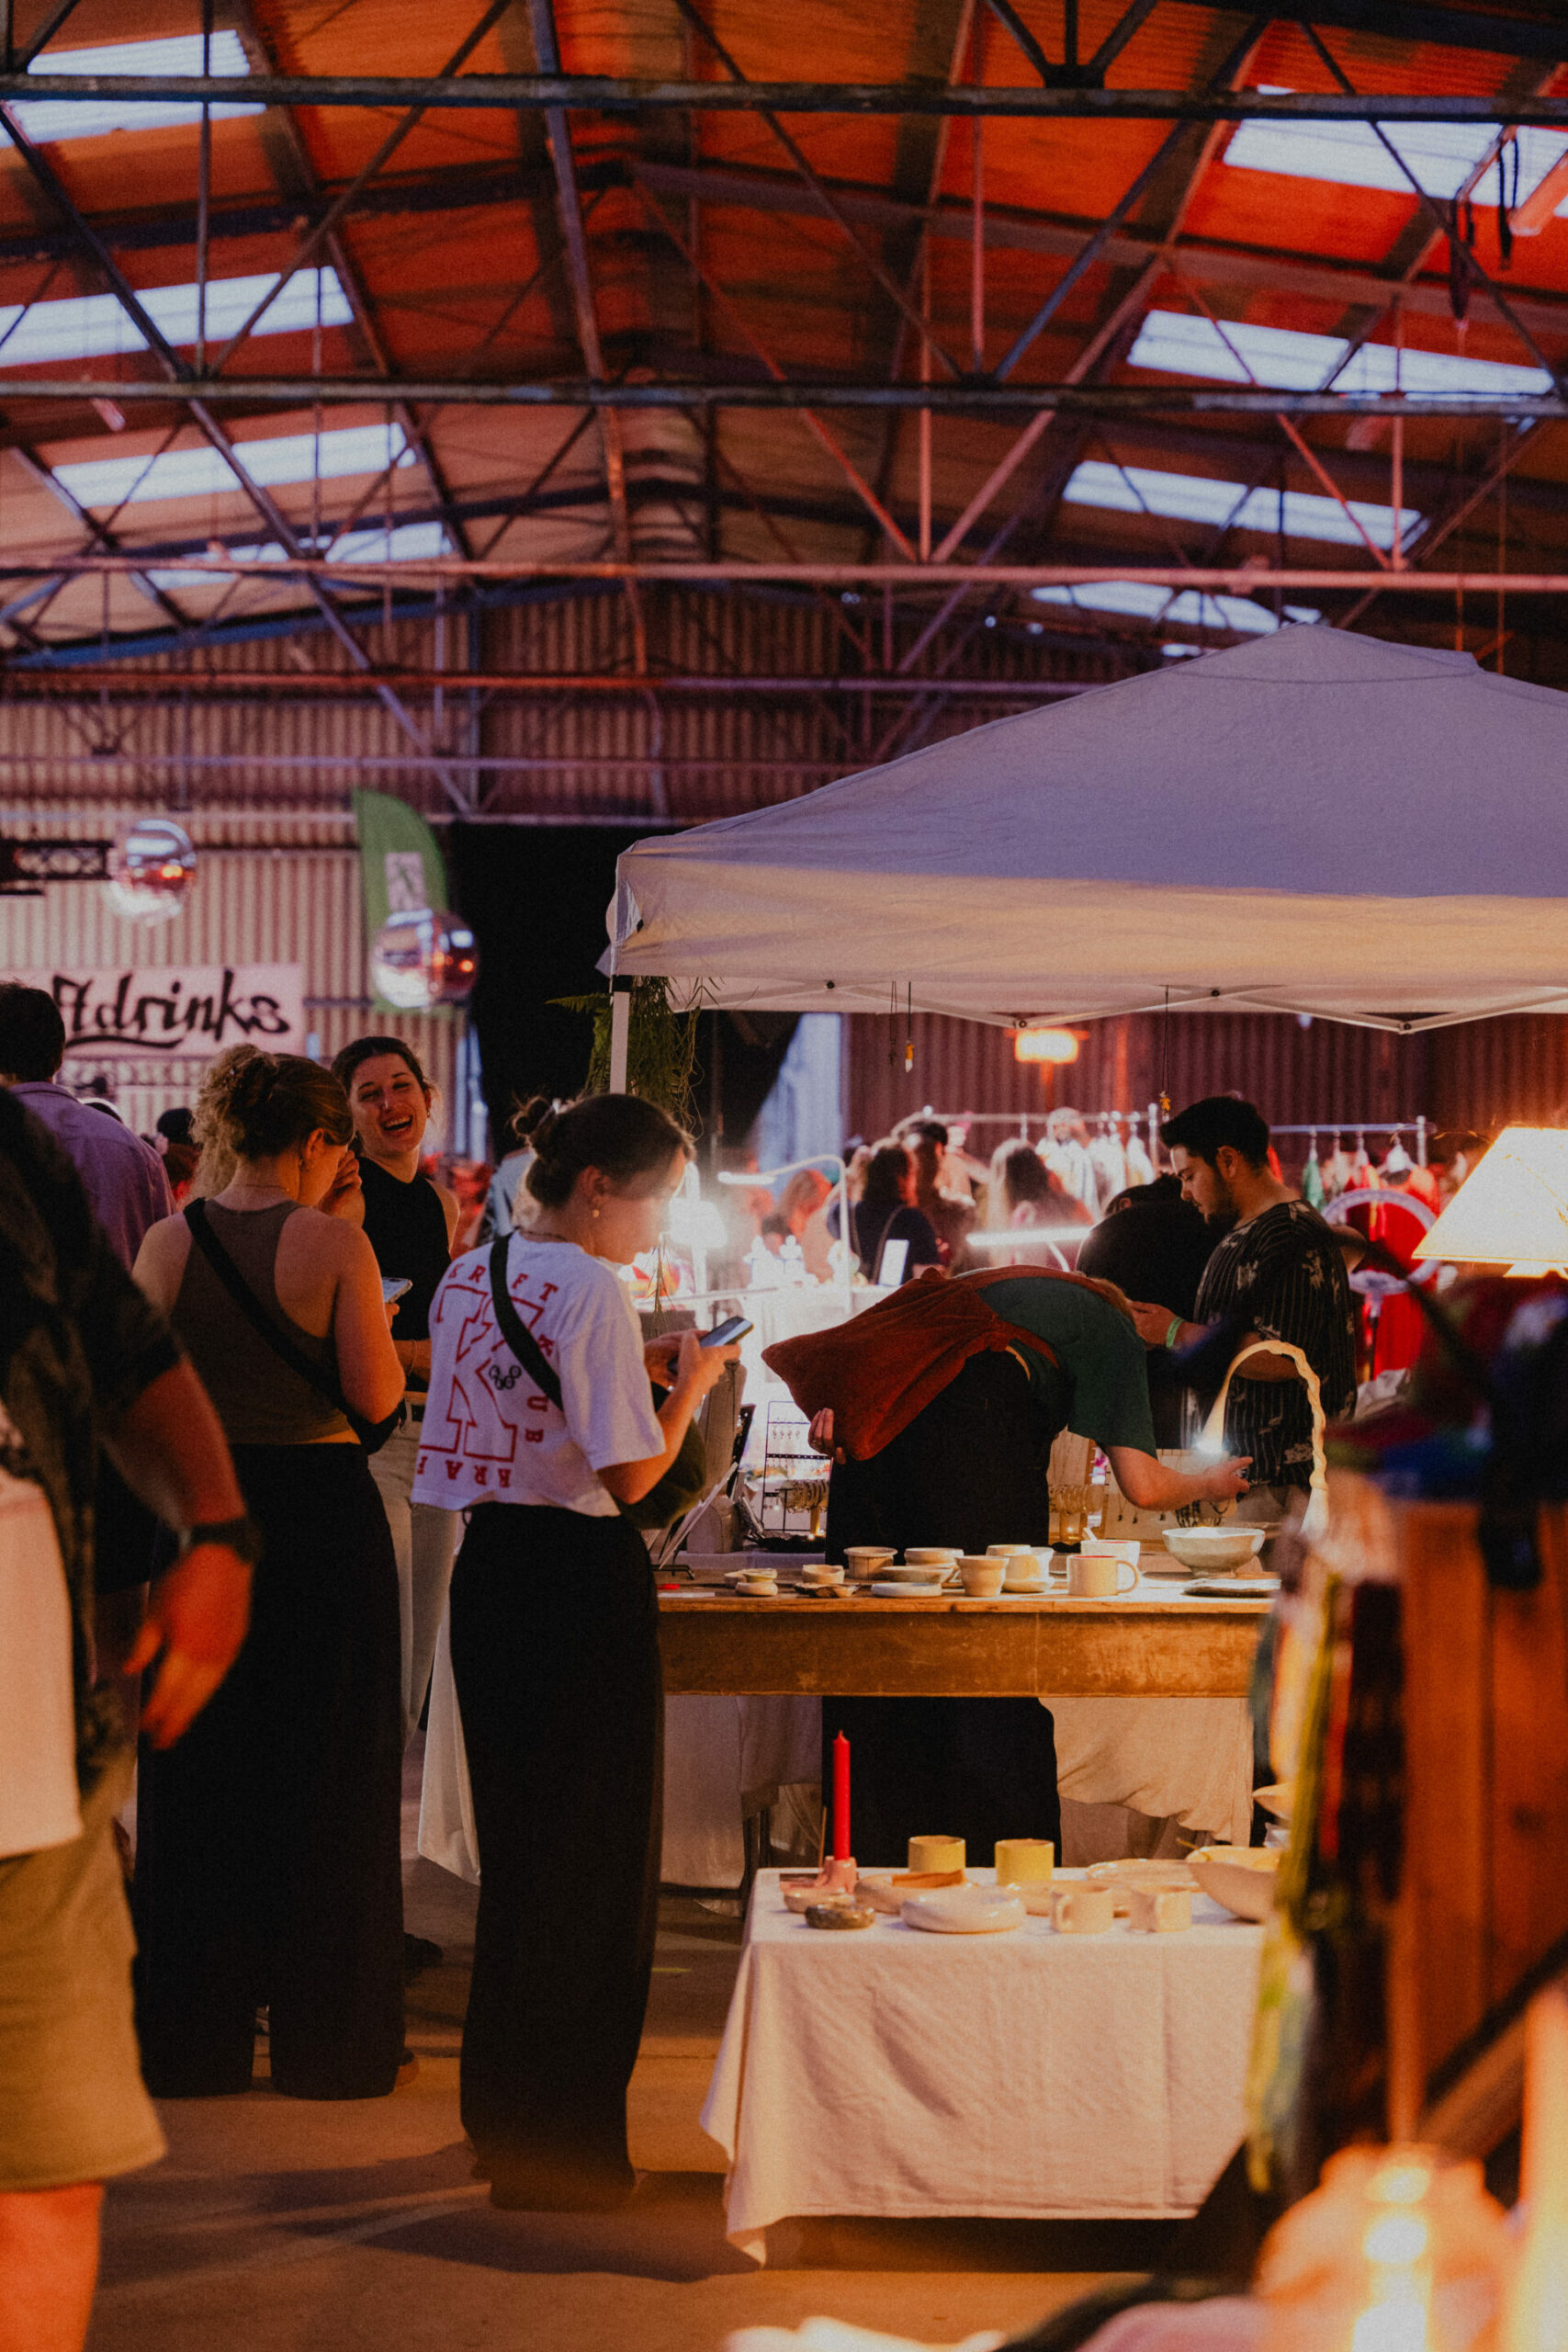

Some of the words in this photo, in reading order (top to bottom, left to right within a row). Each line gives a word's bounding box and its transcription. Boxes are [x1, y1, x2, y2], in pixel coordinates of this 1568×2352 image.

[447, 1262, 558, 1302] KRFT
[525, 1334, 554, 1443] KUB
[416, 1456, 511, 1487] KRAF
